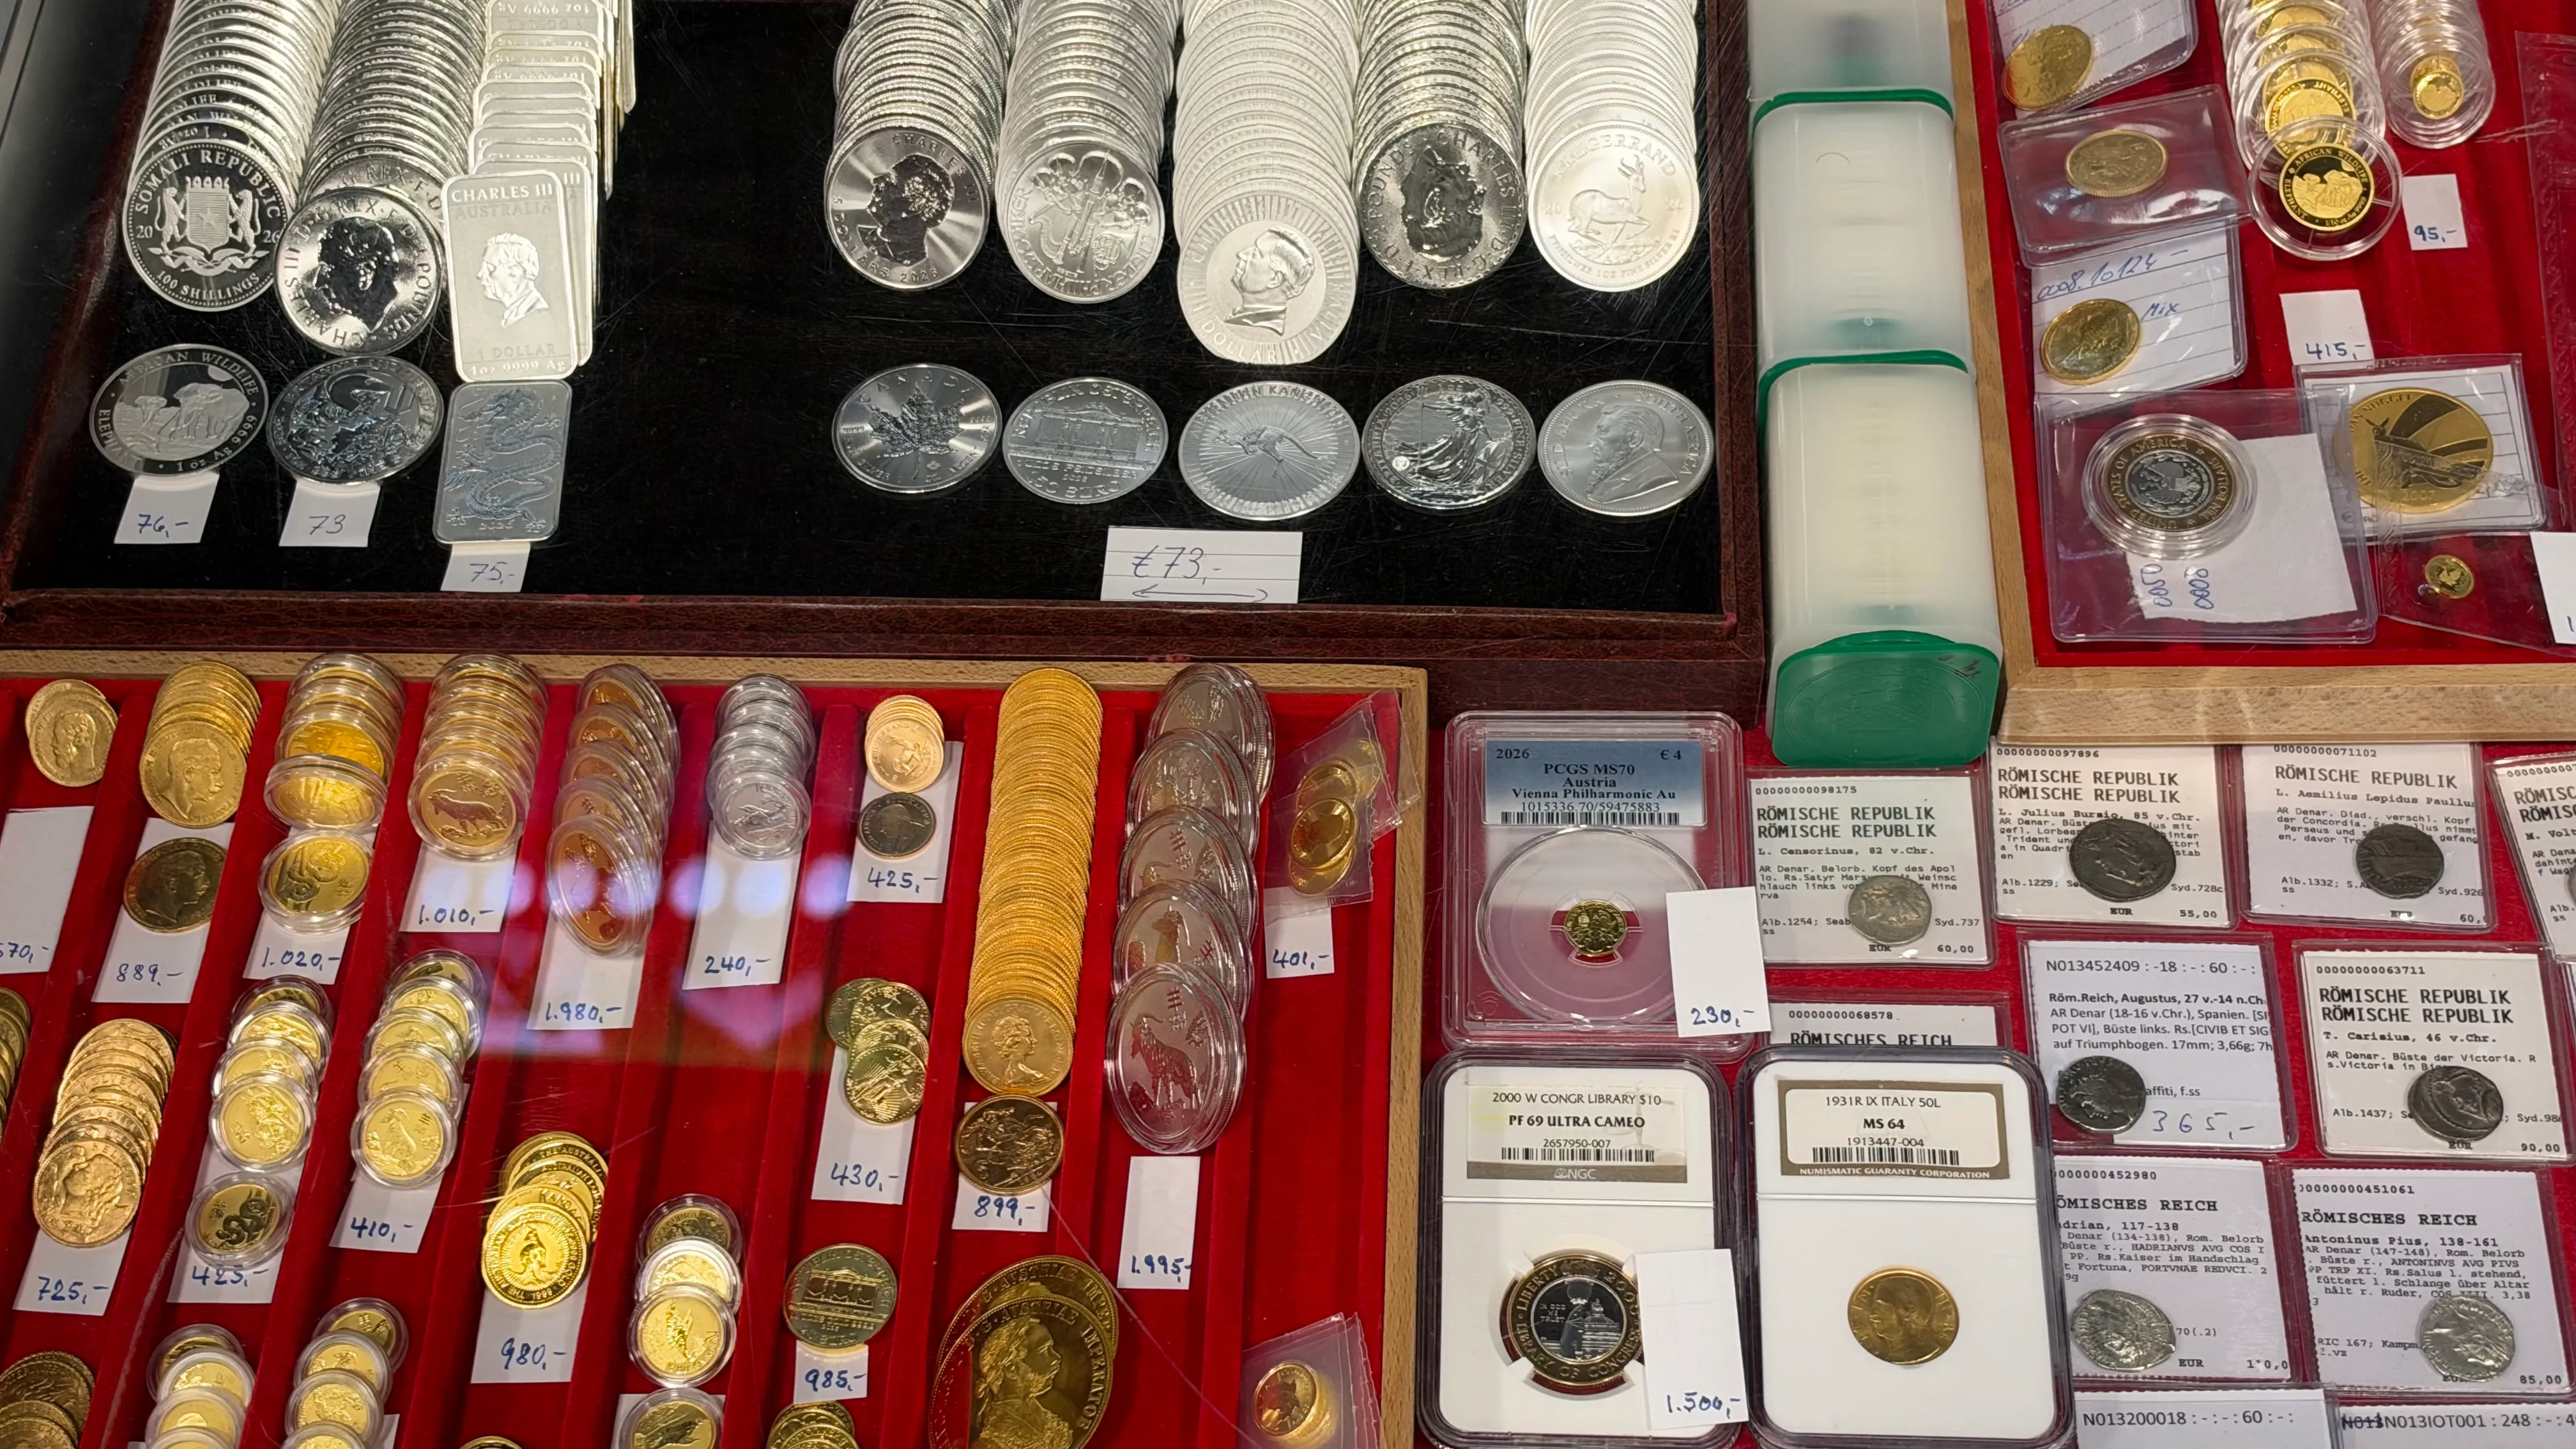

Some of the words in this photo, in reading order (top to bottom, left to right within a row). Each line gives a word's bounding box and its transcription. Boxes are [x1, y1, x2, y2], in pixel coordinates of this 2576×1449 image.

[1554, 134, 1676, 179] KRUGERRAND
[2295, 148, 2332, 167] AFRICAN
[135, 152, 191, 215] SOMALI
[201, 150, 280, 218] REPUBLIC
[451, 187, 530, 203] CHARLES
[535, 183, 552, 197] III
[454, 203, 550, 218] AUSTRALIA
[135, 225, 153, 238] 20
[2413, 225, 2457, 243] 95,-
[157, 271, 178, 289] 100
[180, 273, 260, 300] SHILLINGS
[1202, 319, 1276, 363] DOLLAR
[491, 345, 555, 358] DOLLAR
[2306, 342, 2366, 360] 415,-
[502, 360, 539, 373] 9999
[546, 360, 565, 372] Ag
[202, 353, 259, 395] WILDLIFE
[1633, 390, 1690, 424] SOUTH
[309, 514, 346, 535] 73
[1496, 748, 1530, 760] 2026
[1660, 750, 1669, 760] €
[1673, 750, 1682, 760] 4
[1997, 748, 2099, 758] 00000000097896
[2274, 745, 2377, 758] 00000000071102
[1544, 764, 1588, 774] PCGS
[1593, 764, 1634, 776] MS70
[1997, 767, 2082, 784] RÖMISCHE
[2093, 772, 2179, 786] REPUBLIK
[2275, 765, 2361, 783] RÖMISCHE
[2372, 771, 2458, 789] REPUBLIK
[1563, 778, 1616, 788] Austria
[1756, 785, 1857, 795] 00000000098175
[1512, 789, 1558, 799] Vienna
[1563, 790, 1653, 800] Philharmonic
[1657, 790, 1675, 799] Au
[1998, 785, 2083, 801] RÖMISCHE
[2094, 788, 2180, 804] REPUBLIK
[2298, 790, 2358, 801] Aemilius
[2366, 793, 2418, 804] Lepidus
[1521, 802, 1660, 813] 1015336.70/59475883
[1757, 806, 1840, 821] RÖMISCHE
[1851, 807, 1935, 820] REPUBLIK
[2022, 809, 2065, 817] Julius
[2073, 810, 2124, 819] Bursio,
[2157, 813, 2200, 822] v.Chr.
[1758, 823, 1841, 839] RÖMISCHE
[1852, 824, 1936, 838] REPUBLIK
[1781, 847, 1859, 856] Censorinus,
[867, 867, 939, 894] 425,-
[2281, 877, 2339, 888] Alb.1332;
[417, 903, 496, 926] 1.010,-
[2179, 910, 2218, 919] 55,00
[1761, 918, 1819, 927] Alb.1254;
[1935, 918, 1980, 927] Syd.737
[261, 947, 341, 971] 1.020,-
[704, 954, 771, 977] 240,-
[1273, 948, 1330, 970] 401,-
[2046, 960, 2140, 973] N013452409
[2209, 962, 2228, 974] 60
[2317, 966, 2425, 975] 00000000063711
[2049, 993, 2117, 1004] Röm.Reich,
[2121, 994, 2181, 1005] Augustus,
[2184, 995, 2198, 1004] 27
[2202, 995, 2233, 1004] v.-14
[2319, 986, 2408, 1004] RÖMISCHE
[2420, 989, 2511, 1004] REPUBLIK
[544, 1001, 623, 1023] 1.980,-
[1691, 1006, 1754, 1027] 230,-
[1789, 1010, 1893, 1020] 00000000068578
[2051, 1009, 2067, 1018] AR
[2070, 1009, 2106, 1018] Denar
[2110, 1009, 2149, 1019] (18-16
[2152, 1009, 2195, 1021] v.Chr.),
[2198, 1011, 2250, 1021] Spanien.
[2322, 1005, 2411, 1023] RÖMISCHE
[2423, 1009, 2514, 1023] REPUBLIK
[2052, 1024, 2077, 1034] POT
[2104, 1024, 2136, 1035] Büste
[2140, 1024, 2171, 1035] links.
[2174, 1025, 2228, 1035] Rs.[CIVIB
[2232, 1025, 2246, 1035] ET
[2249, 1025, 2269, 1036] SIG
[2348, 1032, 2416, 1043] Carisius,
[2426, 1033, 2441, 1041] 46
[2450, 1034, 2497, 1043] v.Chr.
[2053, 1039, 2073, 1049] auf
[2076, 1039, 2168, 1052] Triumphbogen.
[2172, 1040, 2214, 1051] 17mm;
[2218, 1041, 2255, 1053] 3,66g;
[2258, 1041, 2273, 1051] 7h
[1492, 1092, 1522, 1103] 2000
[1525, 1093, 1538, 1103] W
[1540, 1093, 1585, 1105] CONGR
[1588, 1094, 1637, 1105] LIBRARY
[1639, 1094, 1662, 1106] $10
[1826, 1096, 1863, 1107] 1931R
[1866, 1097, 1878, 1107] IX
[1882, 1097, 1915, 1107] ITALY
[1919, 1098, 1941, 1108] 50L
[2333, 1108, 2393, 1119] Alb.1437;
[1508, 1115, 1524, 1126] PF
[1528, 1116, 1544, 1127] 69
[1547, 1116, 1591, 1128] ULTRA
[1594, 1116, 1645, 1128] CAMEO
[1863, 1118, 1883, 1129] MS
[1887, 1119, 1905, 1130] 64
[1544, 1138, 1611, 1149] 2657950-007
[1847, 1137, 1924, 1147] 1913447-004
[2520, 1143, 2560, 1153] 90,00
[830, 1162, 900, 1192] 430,-
[1567, 1169, 1597, 1180] NGC
[1920, 1170, 1989, 1179] CORPORATION
[2160, 1200, 2218, 1211] REICH
[2301, 1209, 2406, 1225] RÖMISCHES
[2418, 1214, 2478, 1226] REICH
[350, 1216, 413, 1243] 410,-
[2121, 1222, 2179, 1231] 117-138
[2304, 1235, 2379, 1245] Antoninus
[2388, 1236, 2429, 1248] Pius,
[2439, 1237, 2499, 1247] 138-161
[37, 1276, 110, 1305] 725,-
[1517, 1264, 1558, 1311] LIBERTY
[500, 1337, 567, 1372] 980,-
[2178, 1359, 2204, 1367] EUR
[804, 1368, 866, 1394] 985,-
[2520, 1374, 2562, 1385] 85,00
[1666, 1391, 1741, 1419] 1.500,-
[2083, 1411, 2187, 1427] N013200018
[2242, 1411, 2263, 1425] 60
[2501, 1412, 2531, 1429] 248
